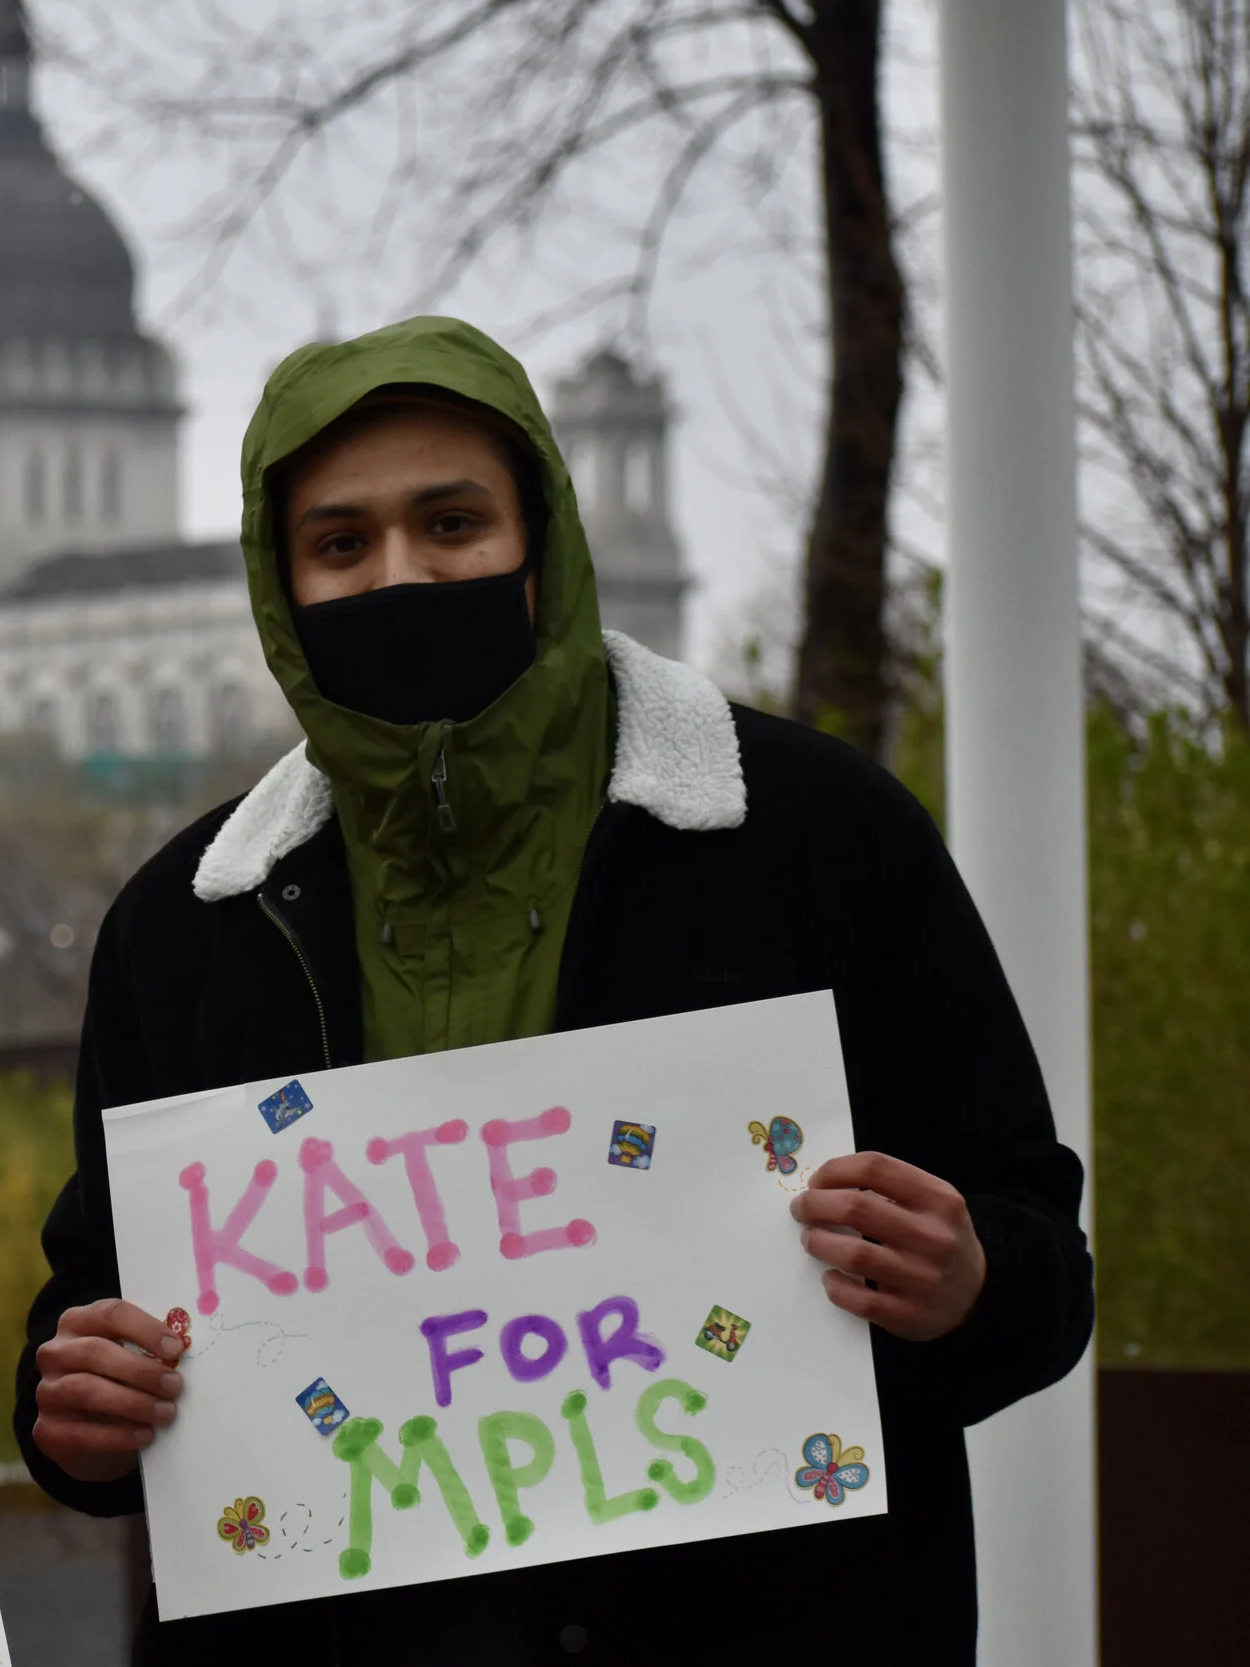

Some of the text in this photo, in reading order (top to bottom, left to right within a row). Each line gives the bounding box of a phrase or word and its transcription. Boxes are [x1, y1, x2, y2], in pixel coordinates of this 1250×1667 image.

[178, 1106, 597, 1315] KATE
[420, 1295, 666, 1406] FOR
[333, 1378, 716, 1578] MPLS
